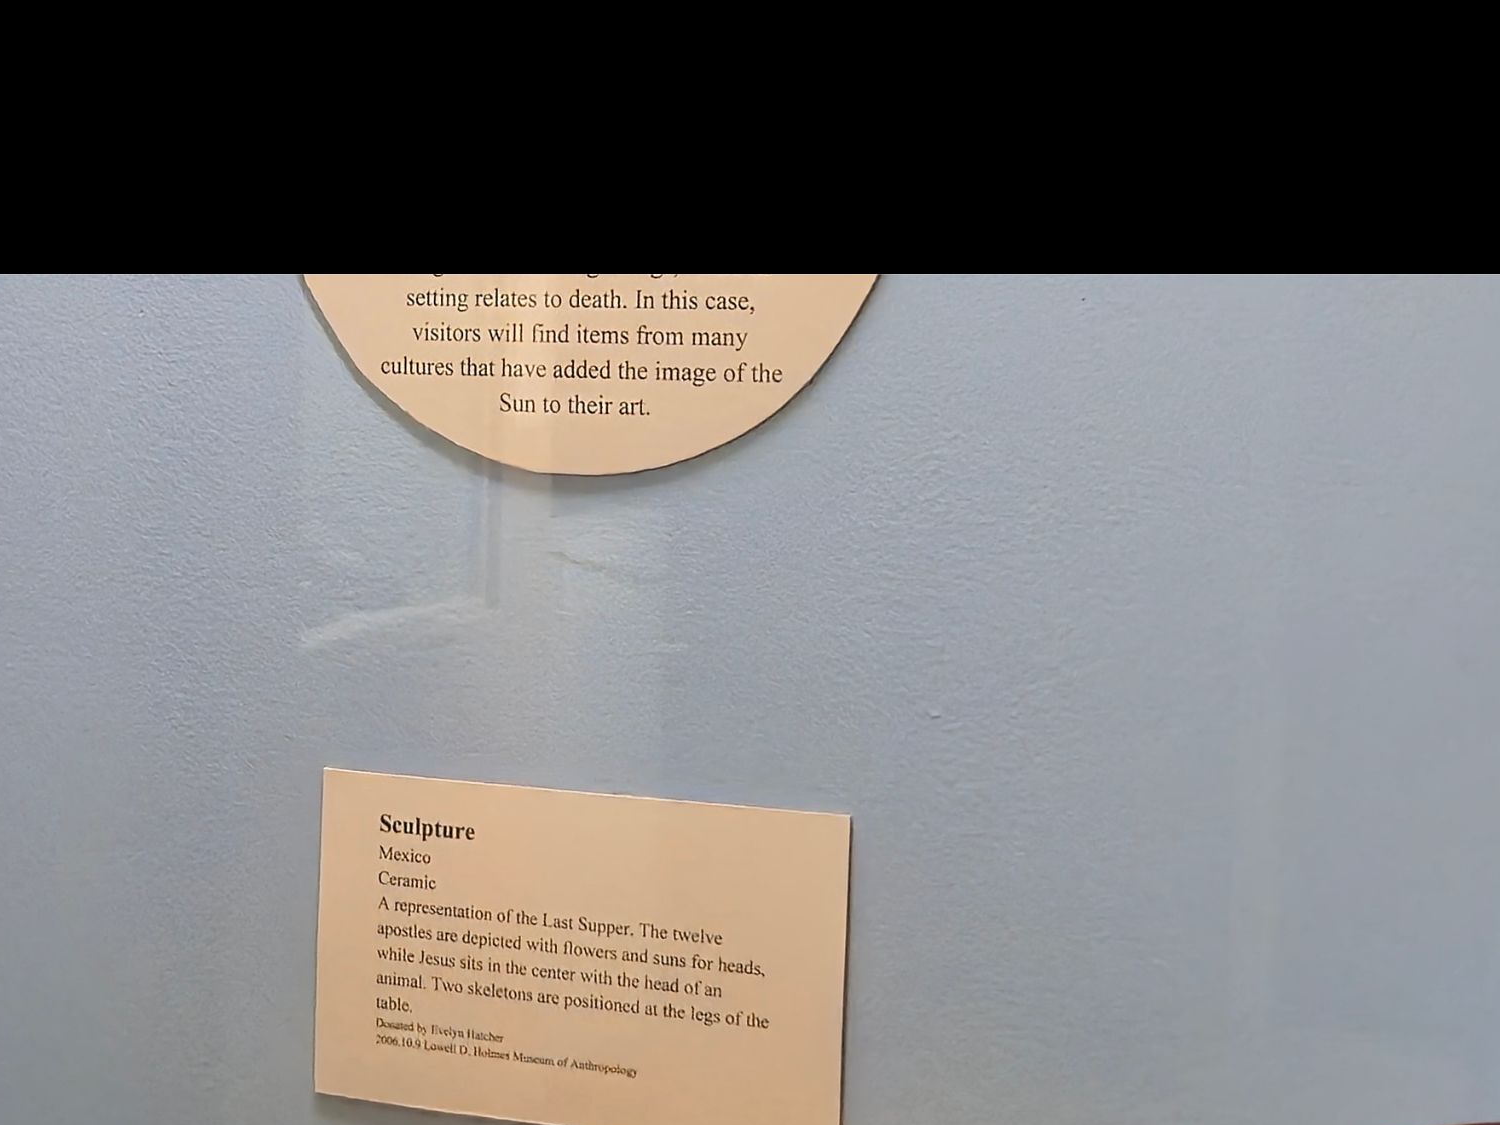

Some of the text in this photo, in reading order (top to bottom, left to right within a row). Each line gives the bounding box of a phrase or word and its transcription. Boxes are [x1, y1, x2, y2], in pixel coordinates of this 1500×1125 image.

[406, 287, 755, 315] setting relates to death. In this case,
[412, 321, 748, 352] visitors will find items from many
[380, 355, 783, 388] cultures that have added the image of the
[499, 392, 651, 416] Sun to their art.
[379, 813, 476, 842] Sculpture
[379, 844, 431, 865] Mexico
[378, 870, 437, 891] Ceramic
[378, 895, 723, 946] A representation of the Last Supper. The twelve
[376, 923, 766, 978] apostles are depicted with flowers and suns for heads,
[377, 946, 722, 999] while Jesus sits in the center with the head of an
[376, 971, 770, 1029] animal. Two skeletons are positioned at the legs of the
[376, 996, 413, 1014] table.
[416, 1022, 427, 1037] by
[556, 1056, 569, 1068] of
